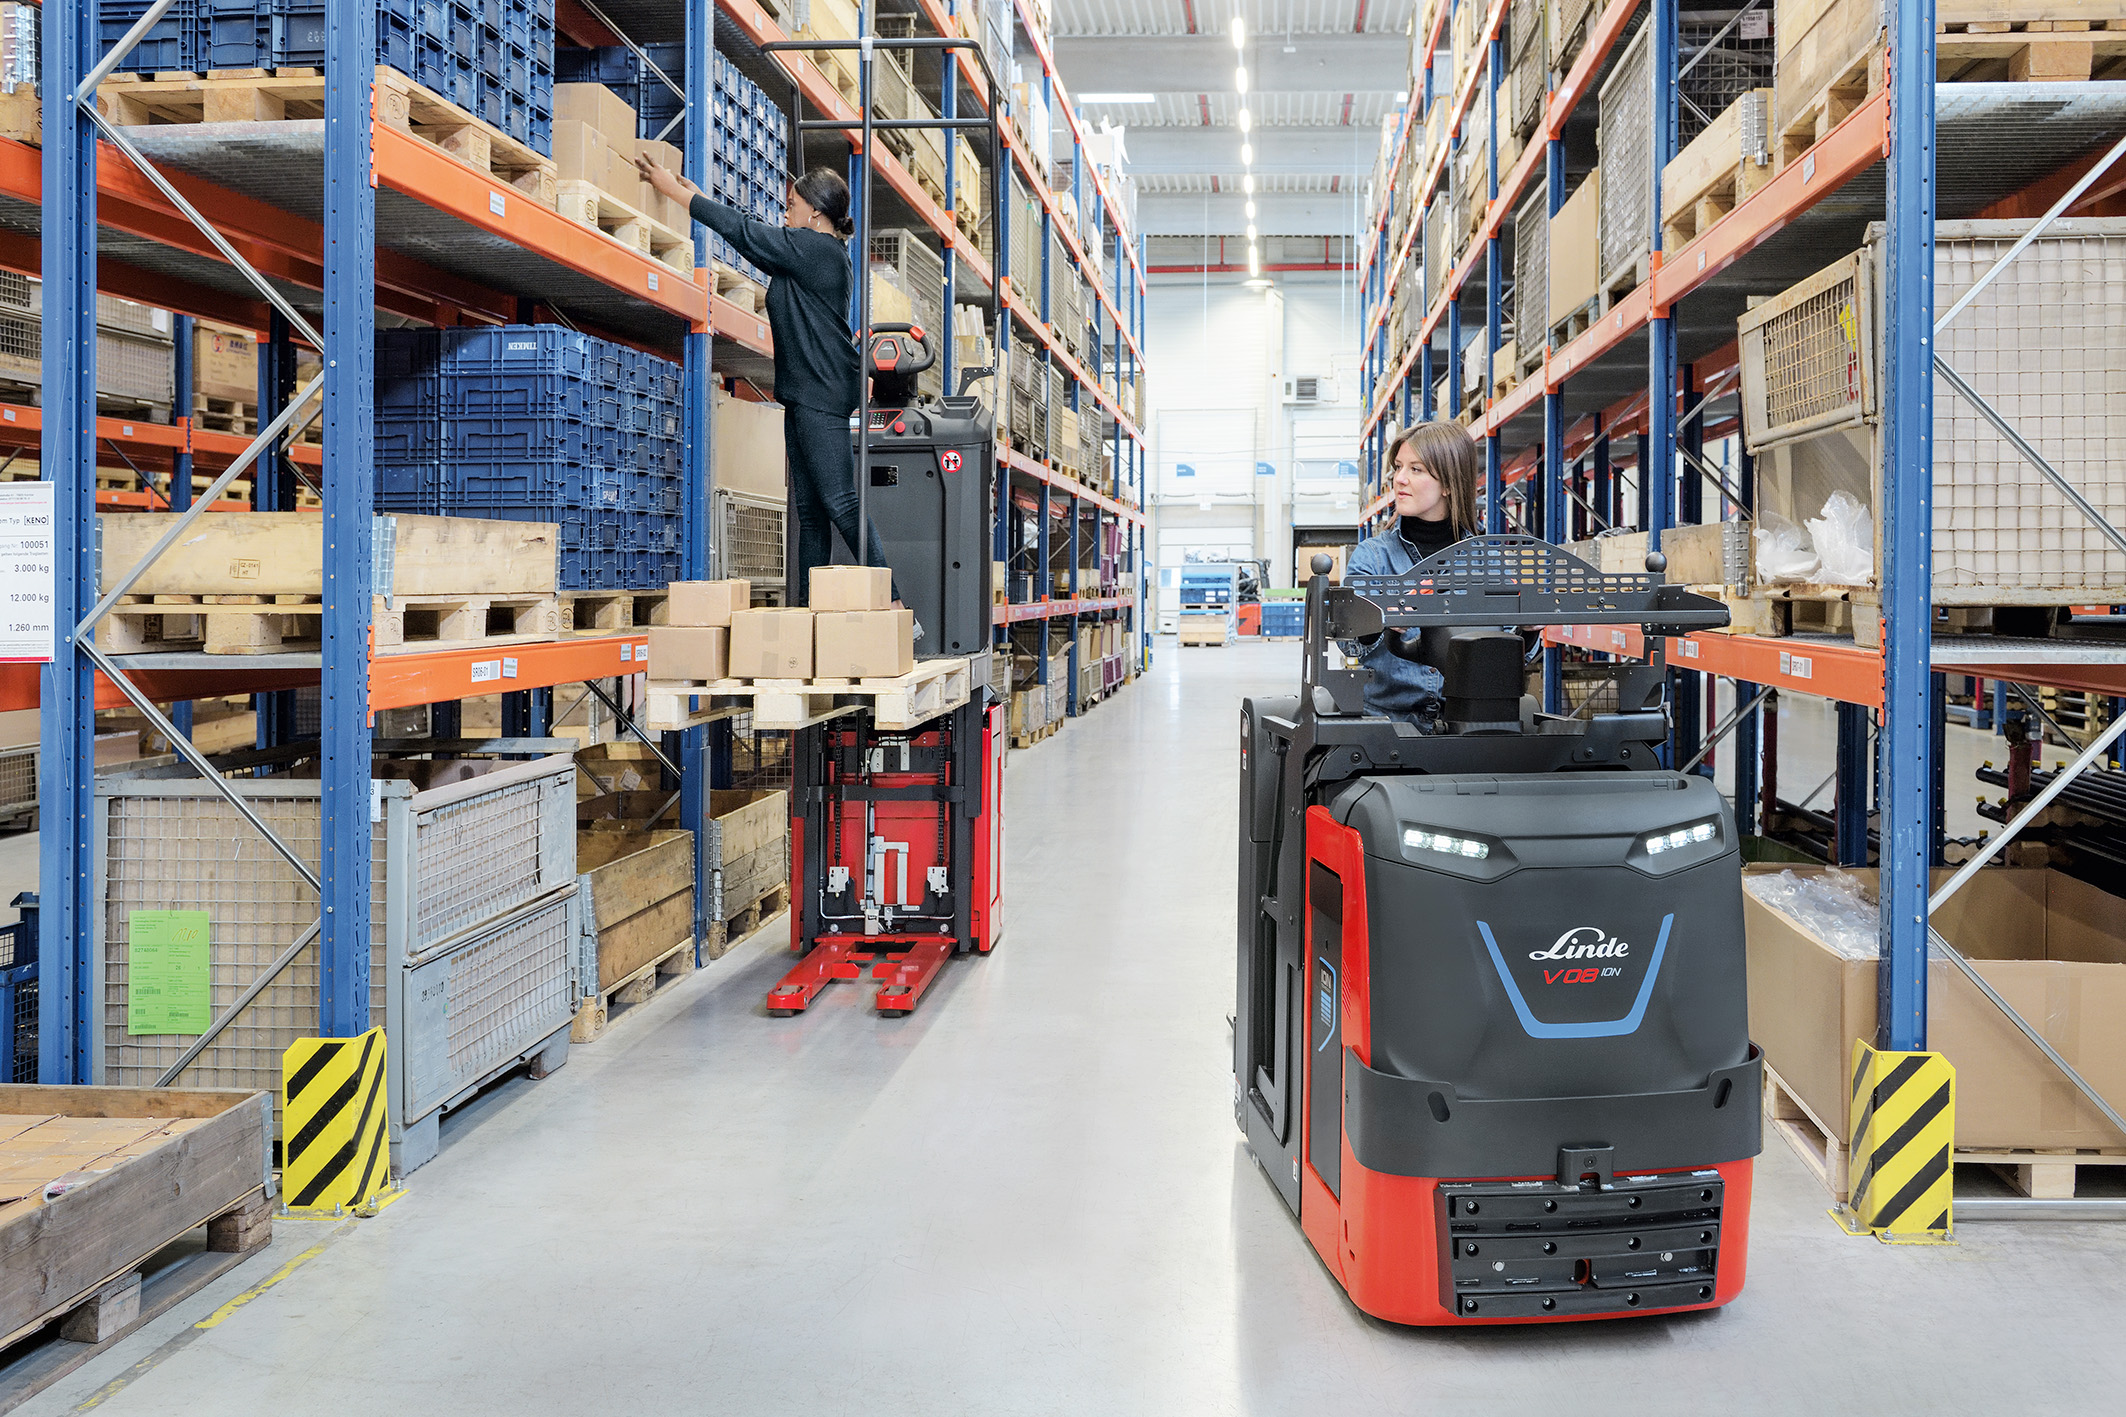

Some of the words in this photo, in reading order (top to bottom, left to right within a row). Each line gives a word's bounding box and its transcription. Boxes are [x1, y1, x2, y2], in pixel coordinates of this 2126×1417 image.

[507, 342, 536, 350] TIMKEN
[20, 540, 48, 548] 100051
[14, 564, 37, 572] 3.000
[39, 564, 49, 573] kg
[10, 593, 37, 602] 12.000
[39, 593, 49, 603] kg
[9, 623, 31, 632] 1.260
[1528, 927, 1629, 960] Linde
[1600, 966, 1622, 977] ION
